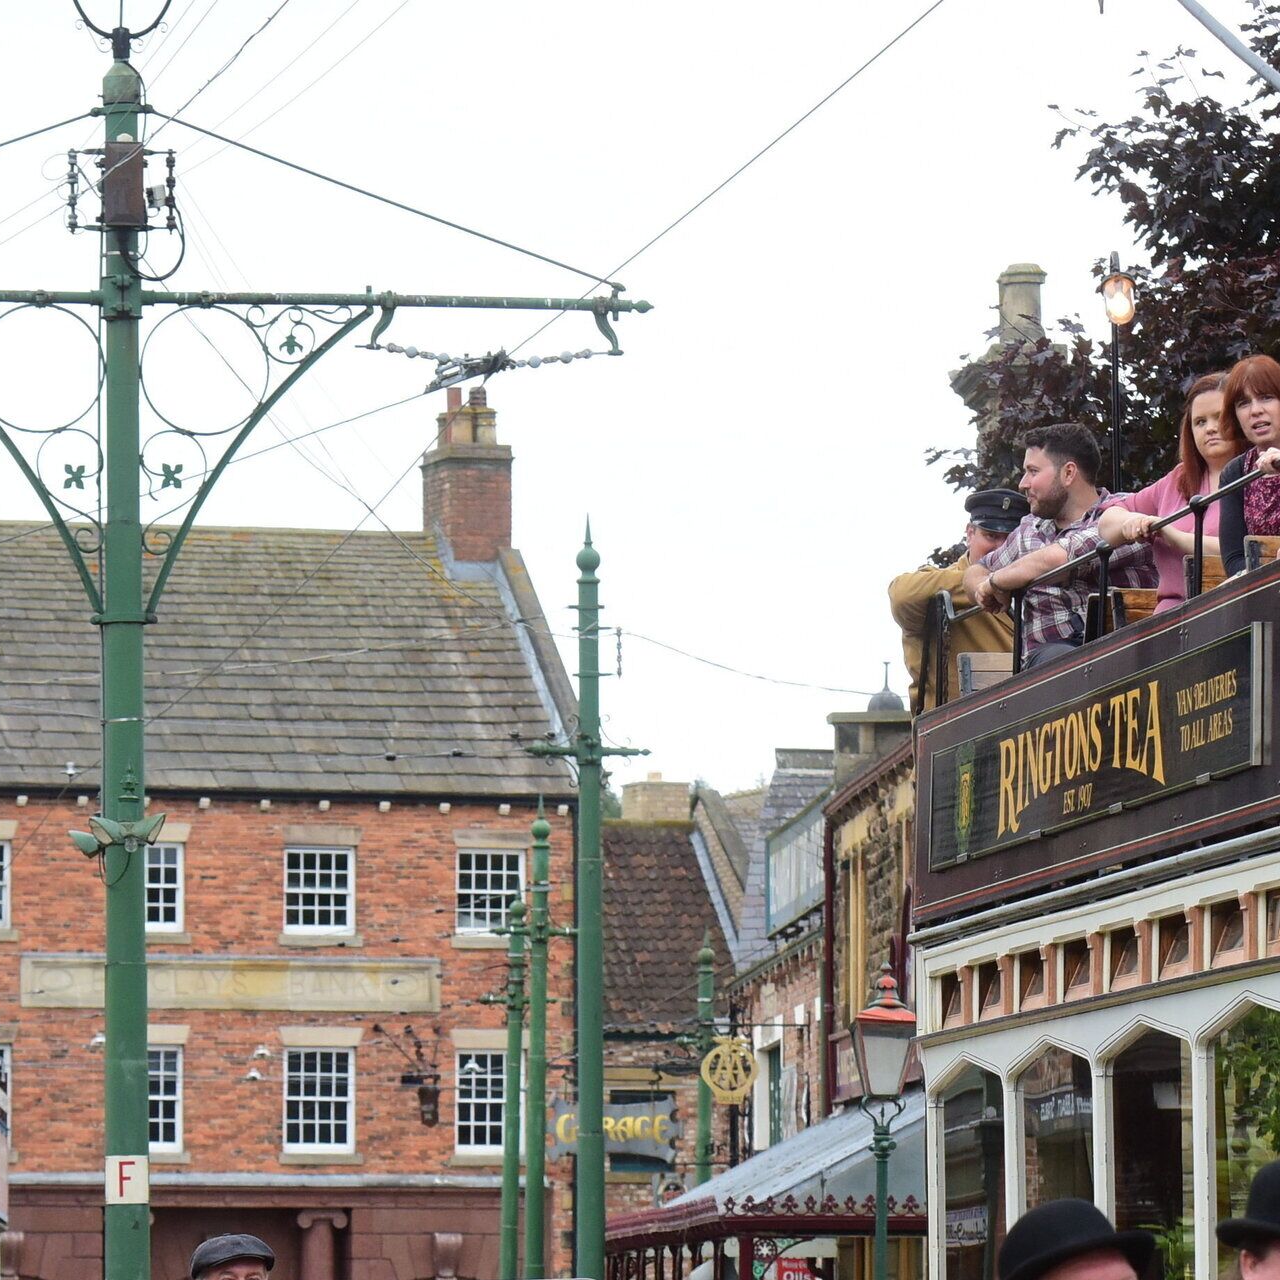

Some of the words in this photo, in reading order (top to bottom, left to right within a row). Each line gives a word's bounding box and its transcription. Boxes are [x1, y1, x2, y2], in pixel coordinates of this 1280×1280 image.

[1176, 687, 1193, 717] VAN
[1193, 668, 1237, 710] DELIVERIES
[1180, 724, 1191, 752] TO
[1191, 718, 1206, 750] ALL
[1207, 707, 1233, 743] AREAS
[997, 703, 1102, 840] RINGTONS
[1108, 680, 1166, 786] TEA
[1078, 782, 1093, 812] 1907
[92, 969, 246, 997] BCLAYS
[290, 970, 374, 998] BANK
[556, 1113, 669, 1145] GRAGE
[119, 1161, 135, 1197] F
